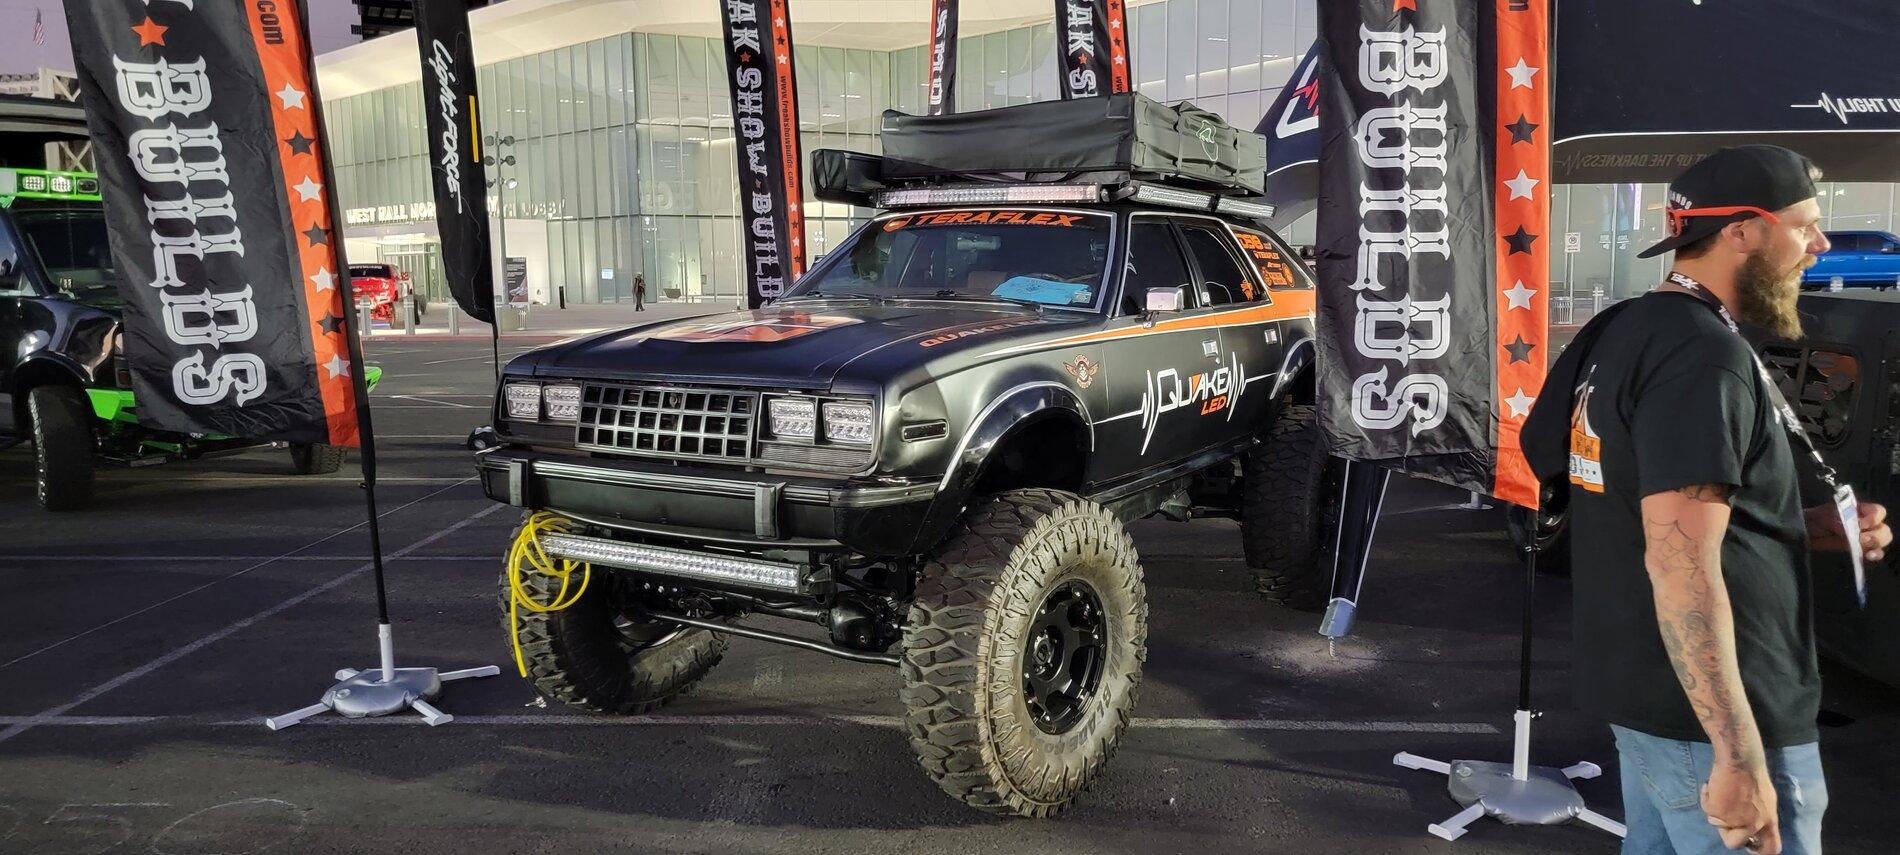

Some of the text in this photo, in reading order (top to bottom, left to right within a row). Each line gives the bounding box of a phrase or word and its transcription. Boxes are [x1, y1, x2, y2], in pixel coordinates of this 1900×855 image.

[736, 65, 768, 177] SHOW
[1838, 98, 1888, 113] LIGHT
[779, 75, 795, 188] www.freakshowbuilds.com
[113, 54, 268, 408] BUILDS
[346, 207, 376, 224] WEST
[378, 204, 408, 222] HALL
[914, 211, 1085, 228] TERAFLEX
[1349, 22, 1452, 438] BUILDS
[1157, 366, 1229, 414] QUAKE
[1200, 395, 1228, 416] LED
